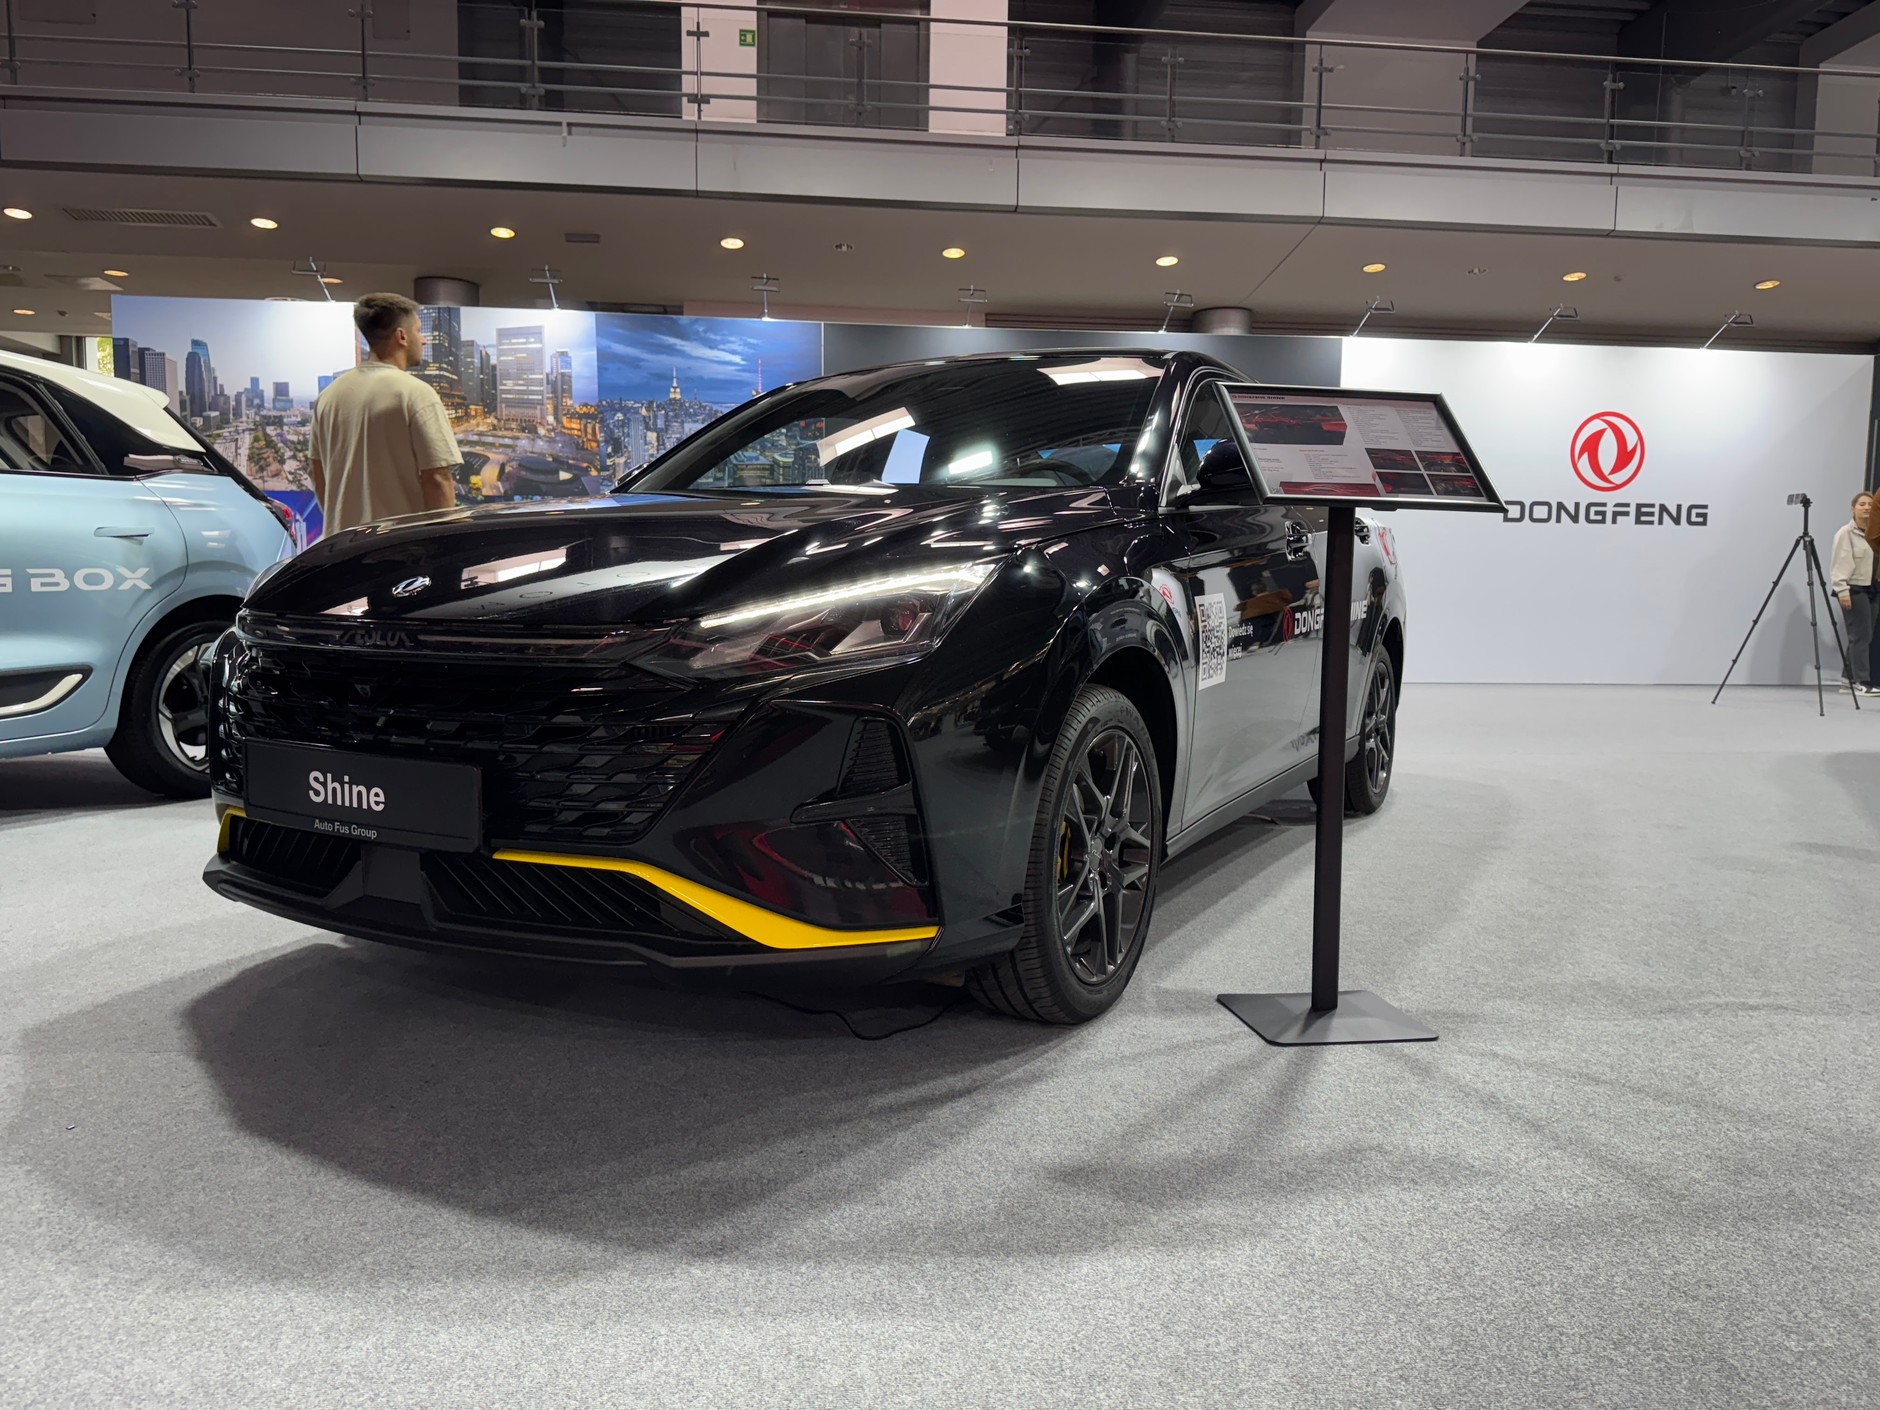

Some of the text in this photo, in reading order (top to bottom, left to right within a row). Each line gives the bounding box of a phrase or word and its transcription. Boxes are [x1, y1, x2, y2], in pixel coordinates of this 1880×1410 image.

[1503, 500, 1709, 526] DONGFENG
[25, 567, 152, 592] BOX
[1294, 607, 1325, 636] DONGF
[308, 770, 386, 812] Shine
[314, 818, 378, 840] Auto Fus Group
